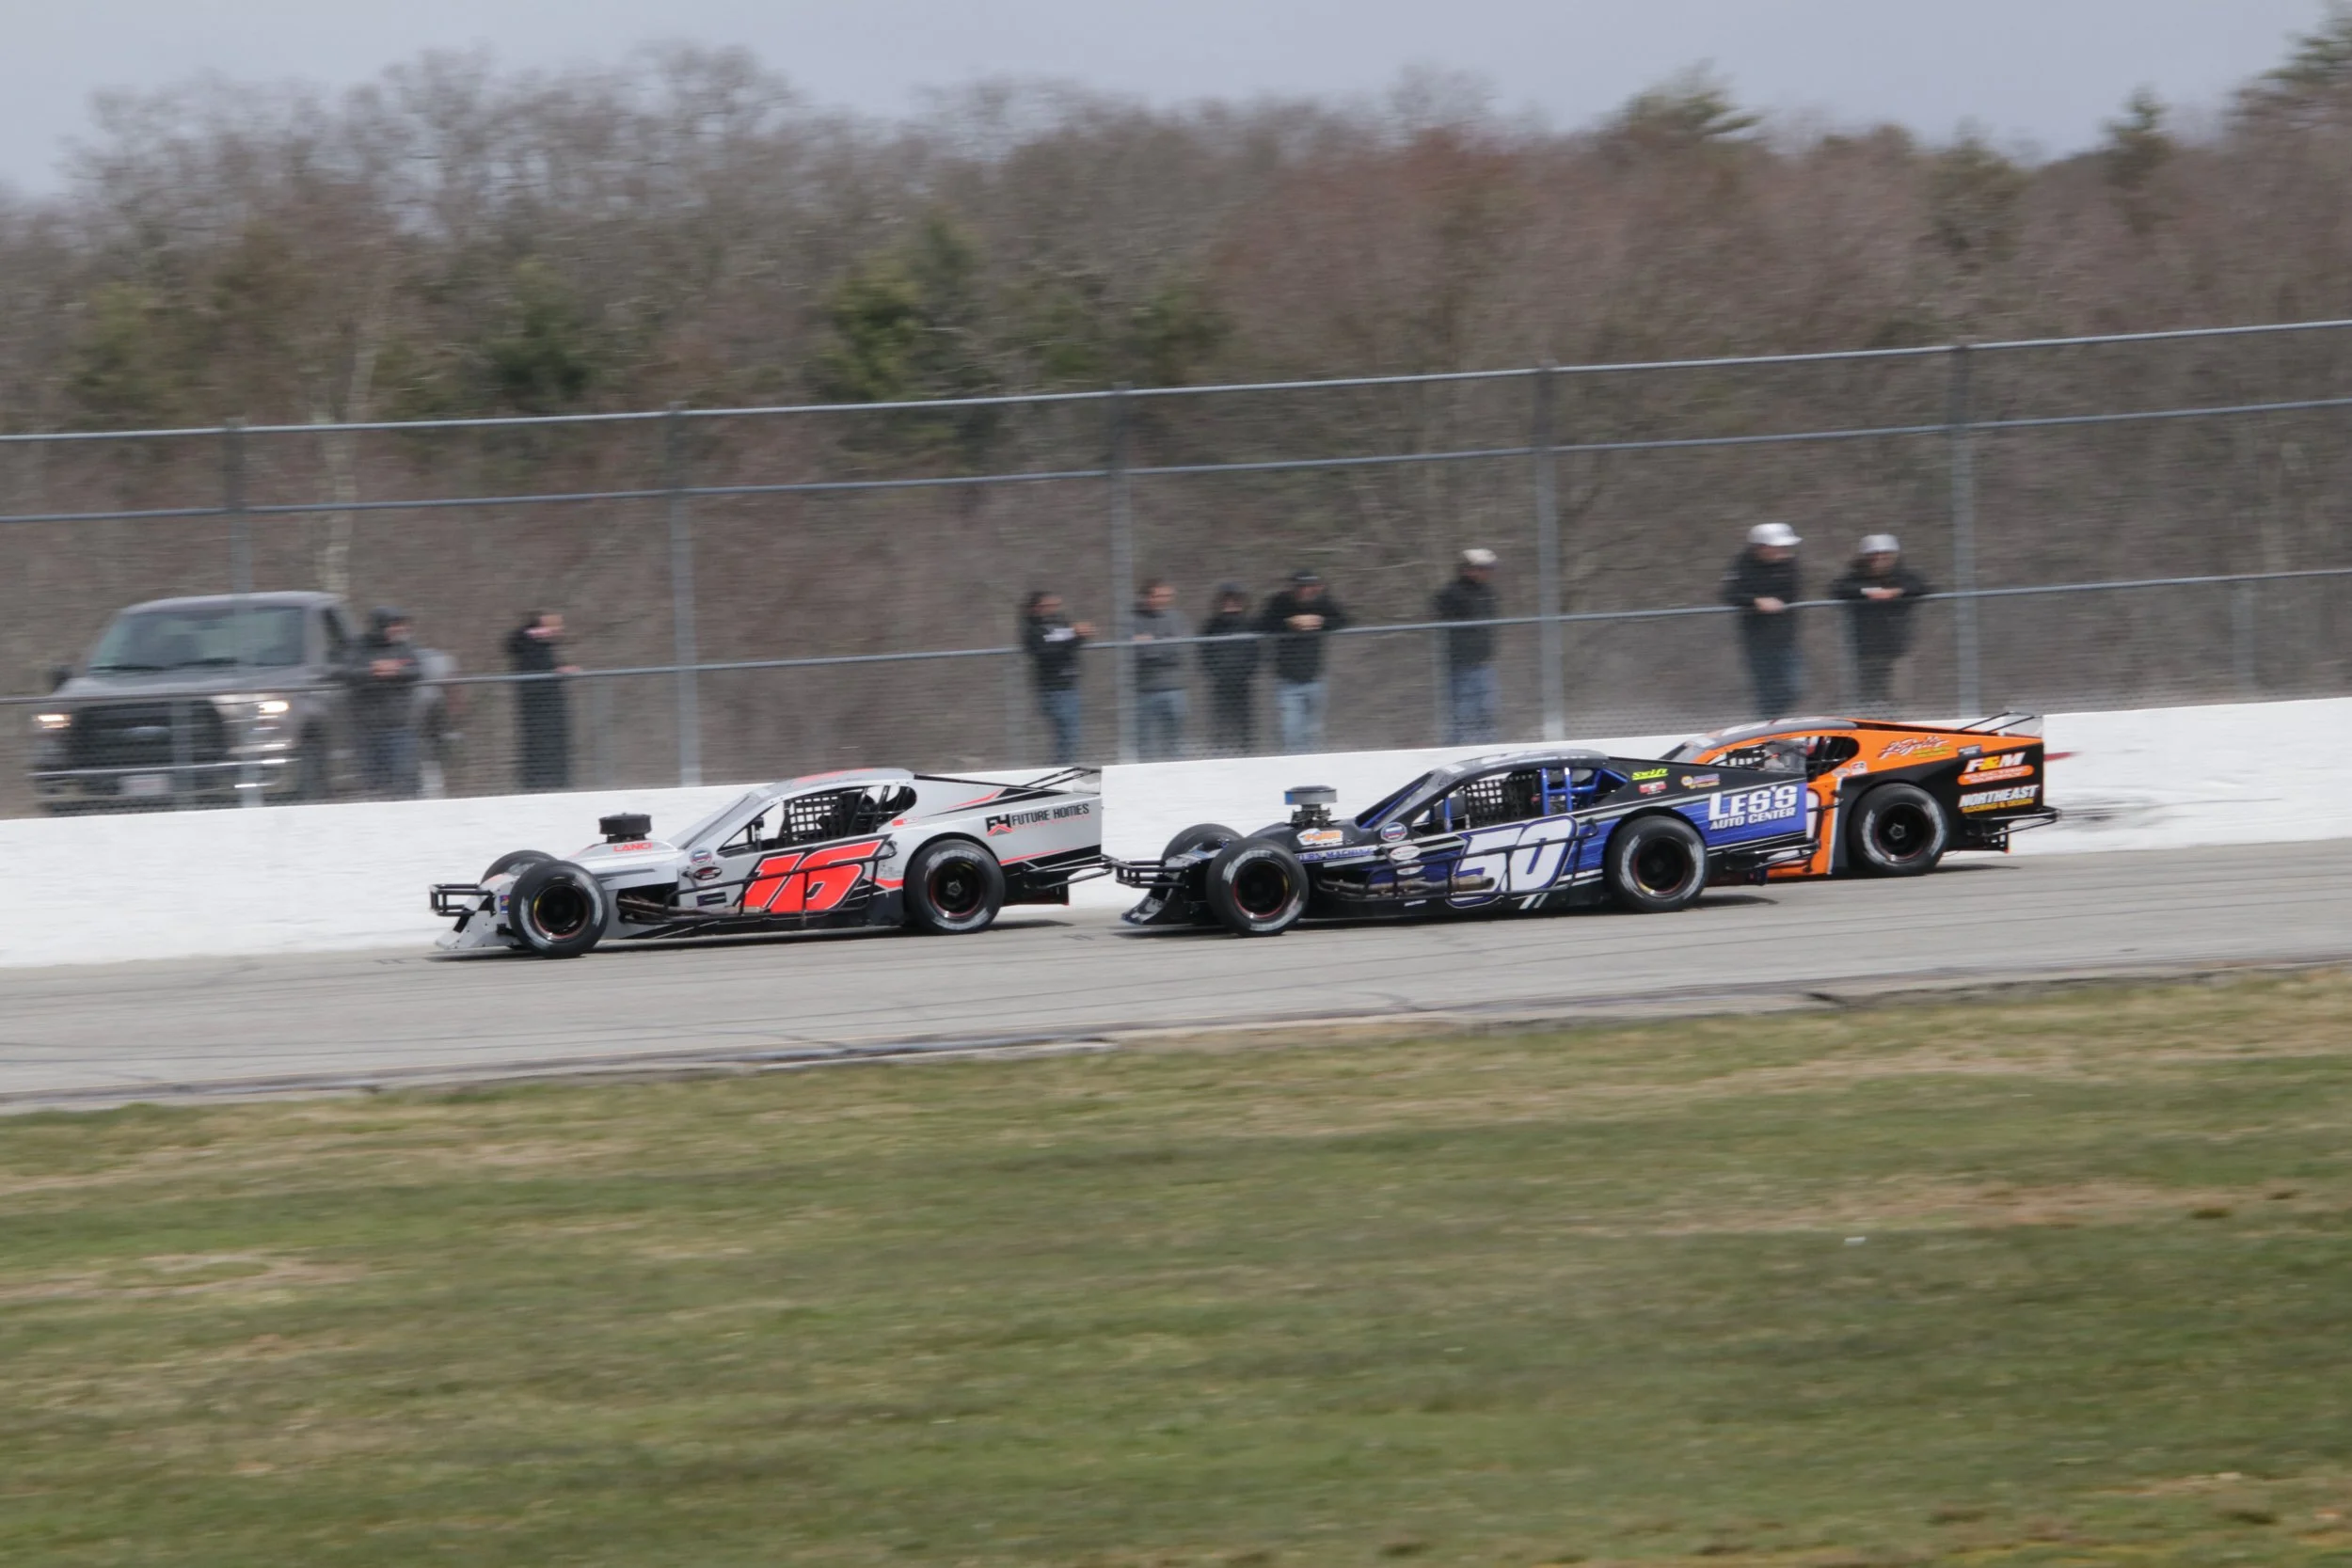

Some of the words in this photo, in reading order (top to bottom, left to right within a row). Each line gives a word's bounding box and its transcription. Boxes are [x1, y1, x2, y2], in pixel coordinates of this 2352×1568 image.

[1632, 768, 1668, 780] Swift
[1963, 752, 2026, 774] F&M
[1958, 784, 2040, 809] NORTHEAST
[1011, 810, 1051, 826] FUTURE
[1053, 803, 1089, 819] HOMES
[1709, 816, 1745, 831] AUTO
[1748, 808, 1797, 825] CENTER
[1447, 816, 1576, 906] 50
[737, 838, 885, 912] 16
